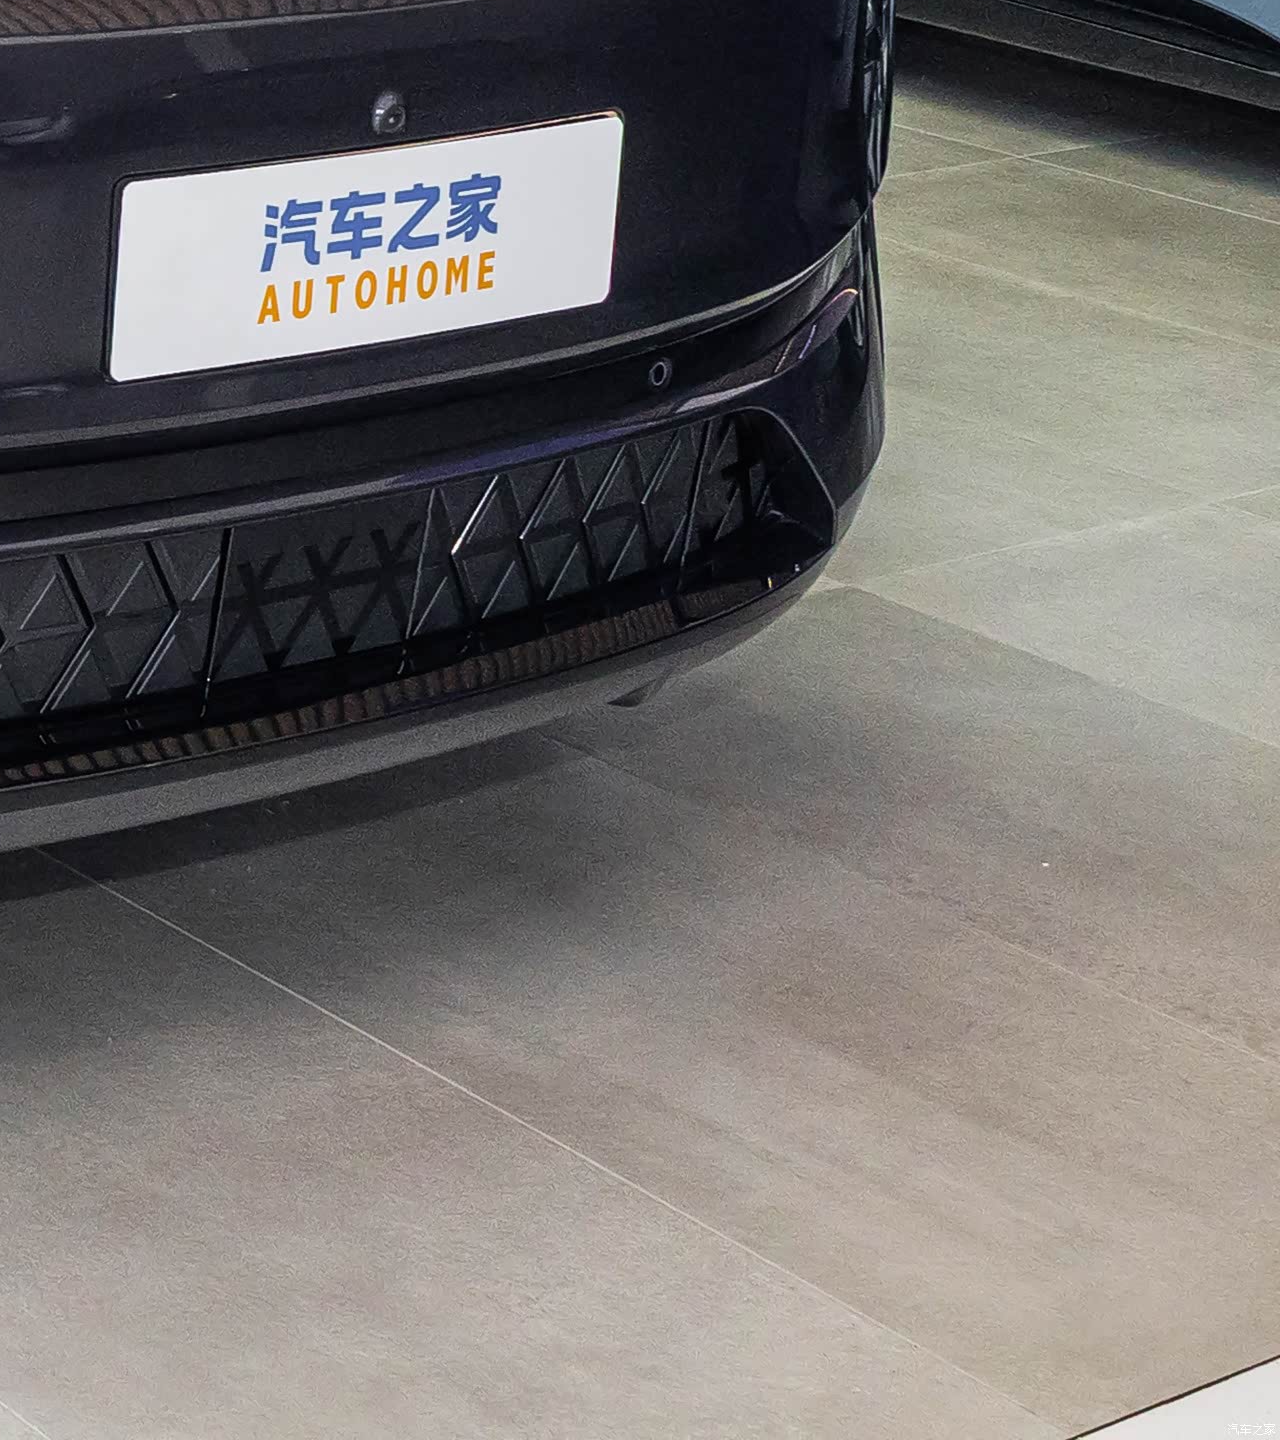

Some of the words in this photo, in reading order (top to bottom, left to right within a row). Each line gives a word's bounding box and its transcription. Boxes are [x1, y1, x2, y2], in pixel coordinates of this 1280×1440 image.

[260, 172, 503, 273] 汽车之家
[257, 250, 497, 325] AUTOHOME
